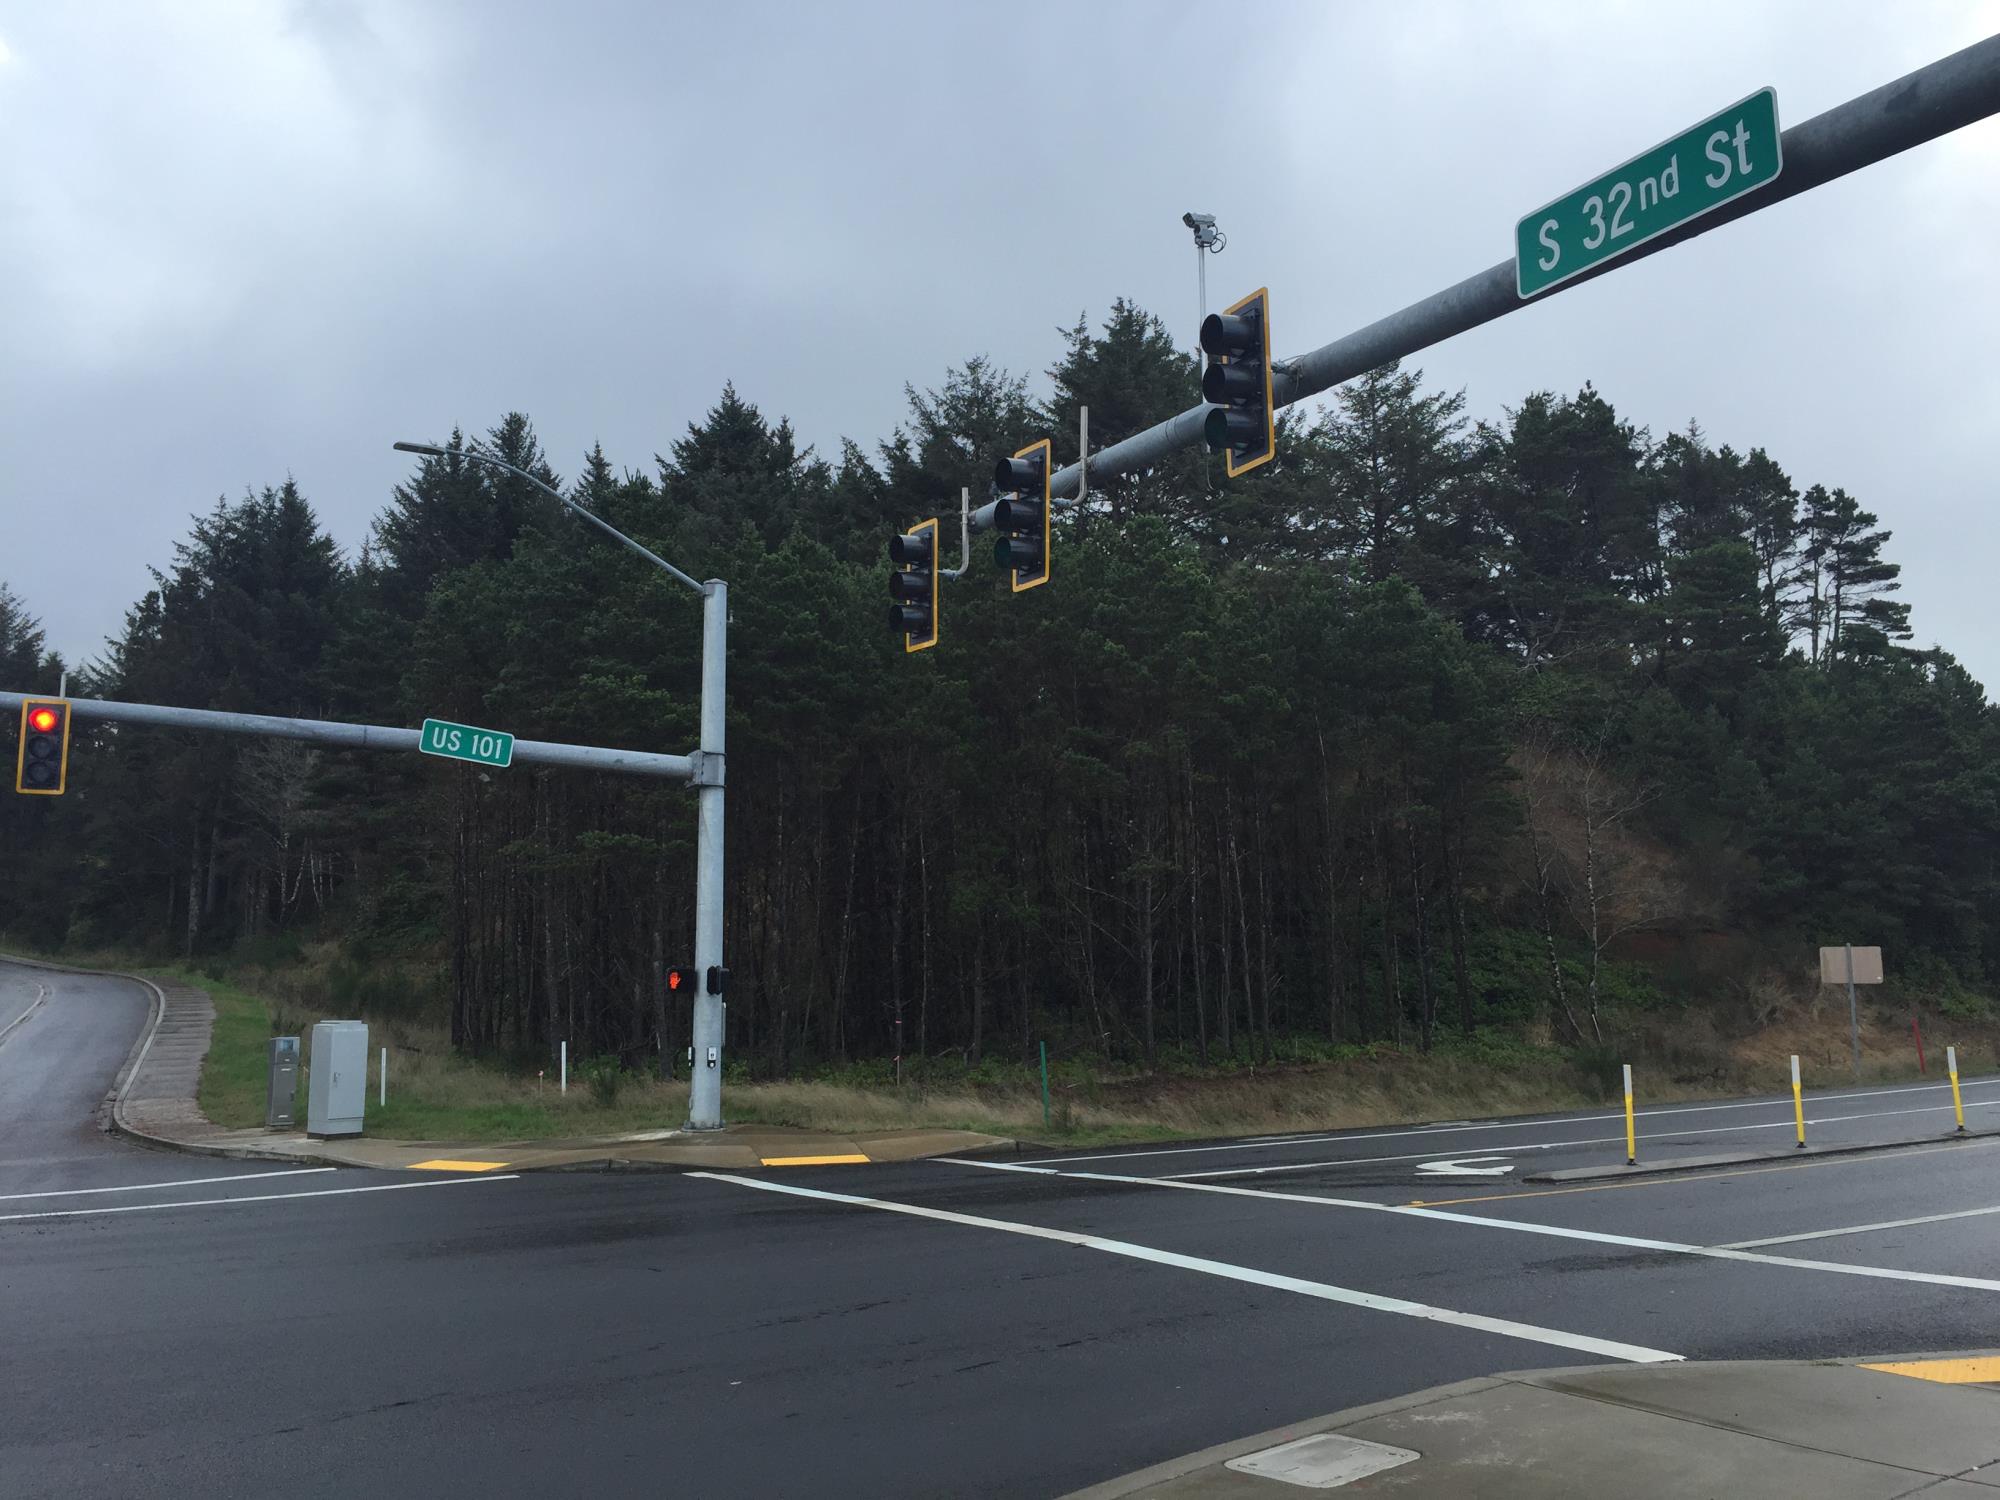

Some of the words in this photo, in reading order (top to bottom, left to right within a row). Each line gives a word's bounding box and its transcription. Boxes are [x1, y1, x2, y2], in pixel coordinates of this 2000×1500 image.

[1538, 218, 1561, 271] S
[1582, 153, 1680, 250] 32nd
[1705, 118, 1753, 189] St
[432, 727, 461, 751] US
[472, 734, 502, 759] 101
